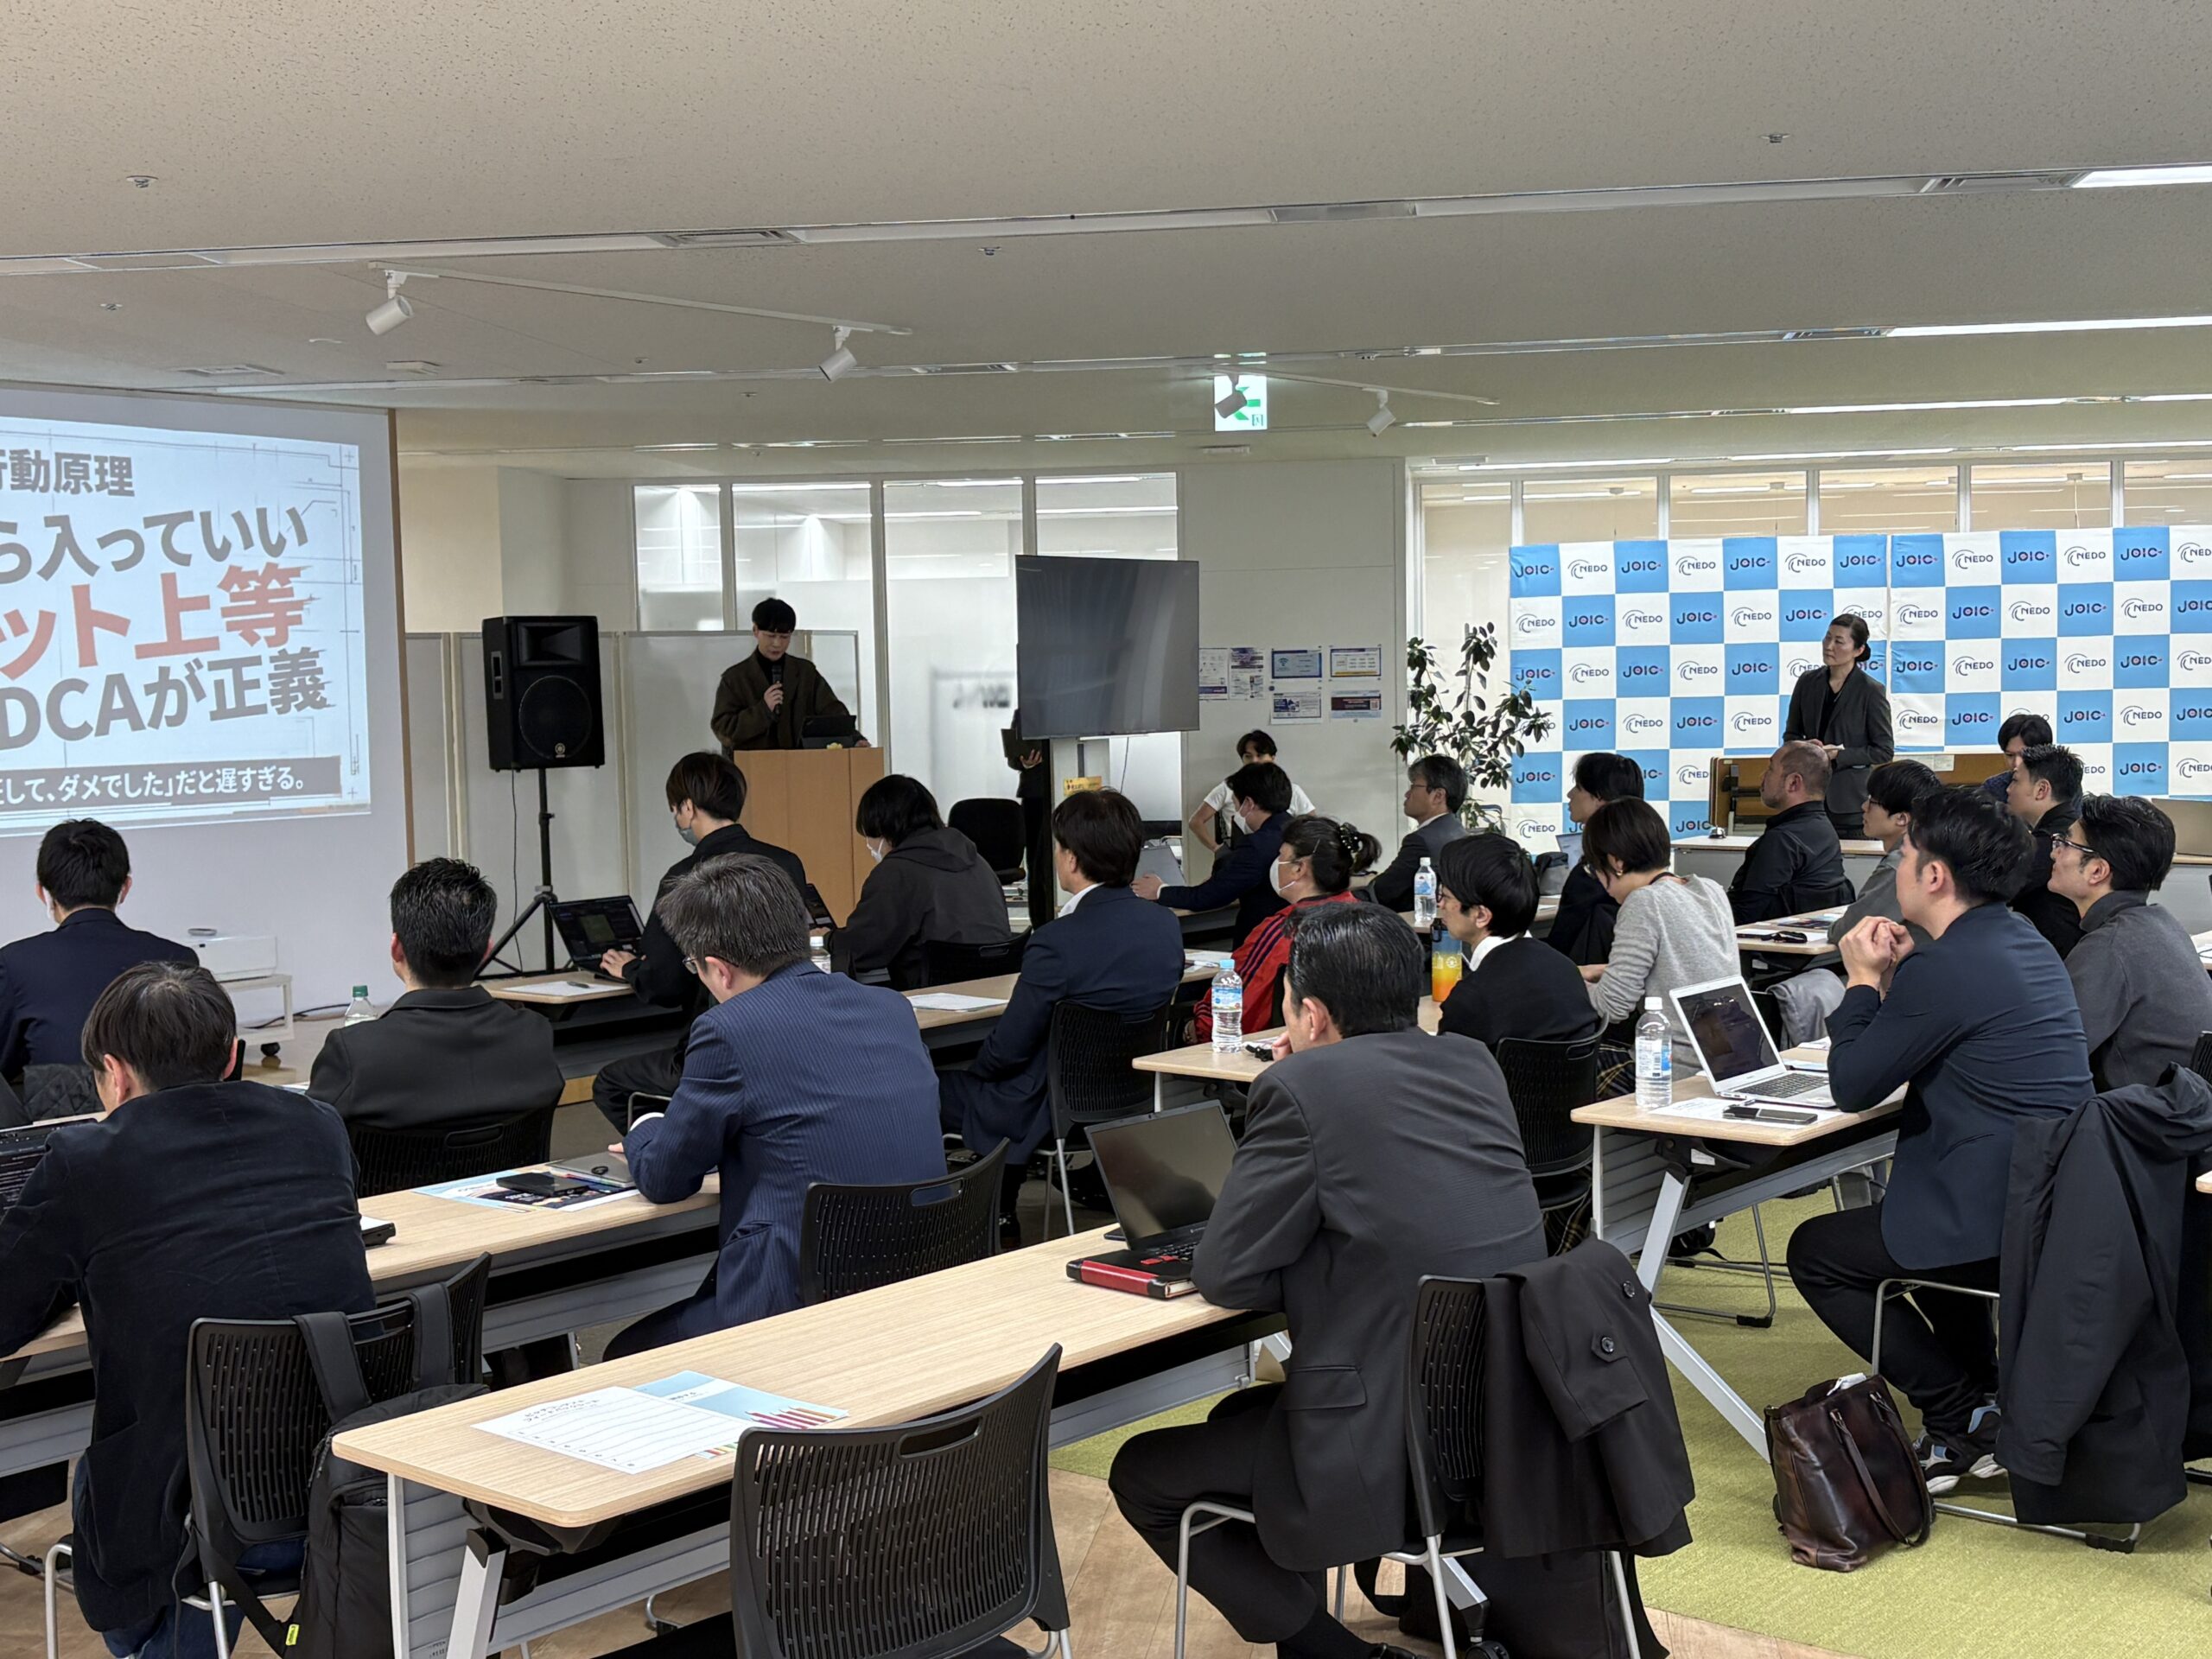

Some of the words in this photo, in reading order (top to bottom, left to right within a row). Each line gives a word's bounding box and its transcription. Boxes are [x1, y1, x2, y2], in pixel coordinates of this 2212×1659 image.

[0, 448, 135, 497] 動原理
[2008, 551, 2046, 563] JOIC
[2077, 551, 2106, 560] NEDO
[2120, 548, 2158, 560] JOIC
[2190, 548, 2212, 556] NED
[1730, 556, 1766, 570] JOIC
[1796, 558, 1826, 568] NEDO
[1840, 555, 1876, 569] JOIC
[1897, 556, 1934, 568] JOIC
[1965, 555, 1993, 563] NEDO
[1580, 563, 1608, 573] NEDO
[1622, 560, 1656, 574] JOIC
[1688, 561, 1716, 570] NEDO
[1786, 609, 1822, 622] JOIC
[1953, 607, 1990, 619] JOIC
[2064, 603, 2102, 616] JOIC
[1528, 618, 1555, 626] NEDO
[1569, 615, 1605, 628] JOIC
[1634, 614, 1662, 623] NEDO
[1677, 612, 1713, 625] JOIC
[1743, 612, 1771, 620] NEDO
[1897, 661, 1935, 673] JOIC
[2008, 658, 2046, 671] JOIC
[2121, 655, 2158, 668] JOIC
[1516, 668, 1551, 682] JOIC
[1580, 669, 1609, 677] NEDO
[1624, 665, 1659, 678] JOIC
[1688, 666, 1718, 675] NEDO
[1732, 663, 1768, 676] JOIC
[0, 647, 334, 751] DCAが正義
[1677, 715, 1713, 728] JOIC
[1743, 716, 1771, 725] NEDO
[1952, 712, 1990, 725] JOIC
[2064, 710, 2101, 723] JOIC
[1569, 718, 1605, 731] JOIC
[1635, 718, 1662, 728] NEDO
[2120, 763, 2158, 775] JOIC
[1516, 771, 1552, 784] JOIC
[0, 766, 303, 804] して、ダメでした」だと遅すぎる。
[1529, 824, 1556, 833] NEDO
